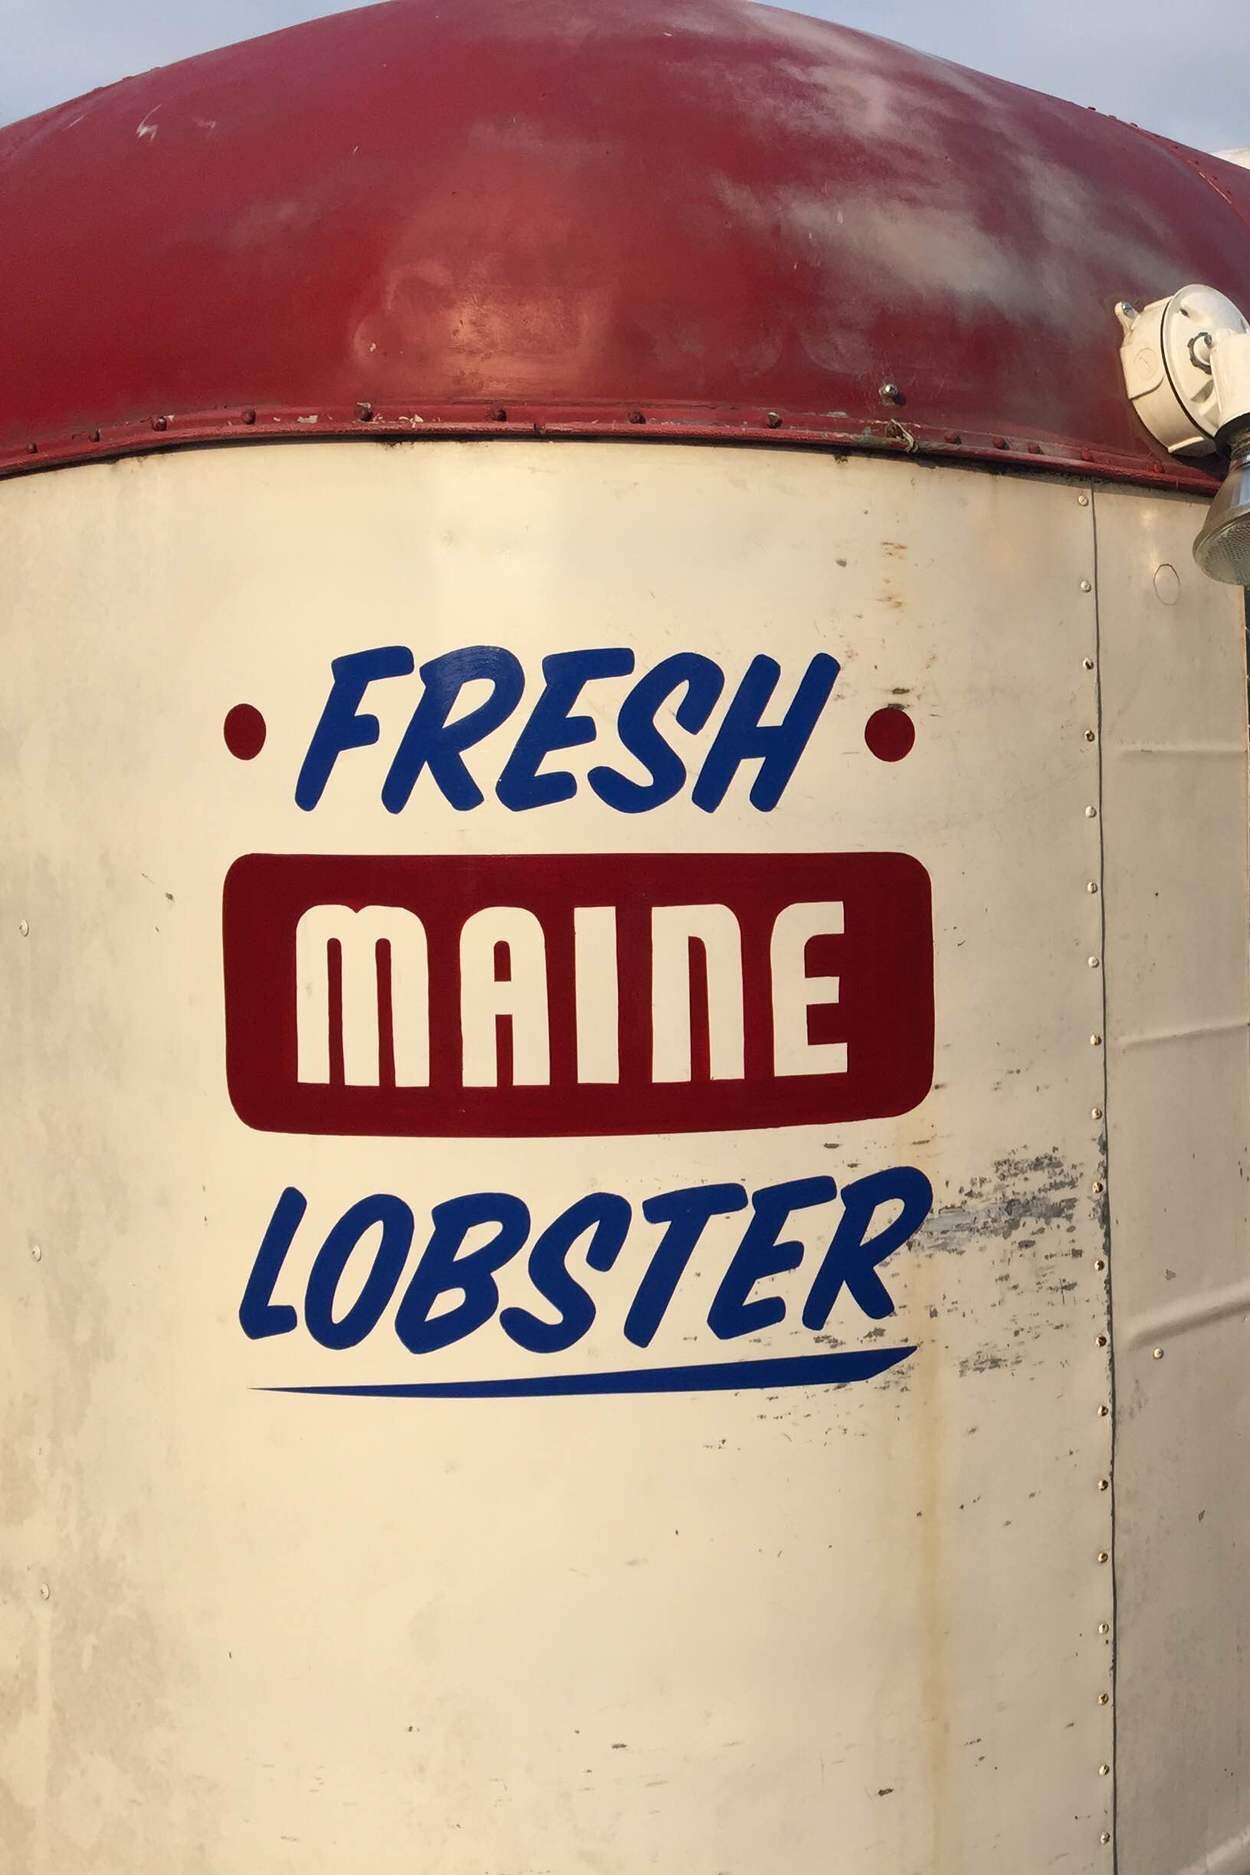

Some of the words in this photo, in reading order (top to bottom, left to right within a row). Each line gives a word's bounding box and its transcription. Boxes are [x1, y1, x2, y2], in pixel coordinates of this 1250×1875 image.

[295, 645, 840, 813] FRESH
[296, 901, 848, 1087] MAINE
[239, 1166, 933, 1354] LOBSTER
